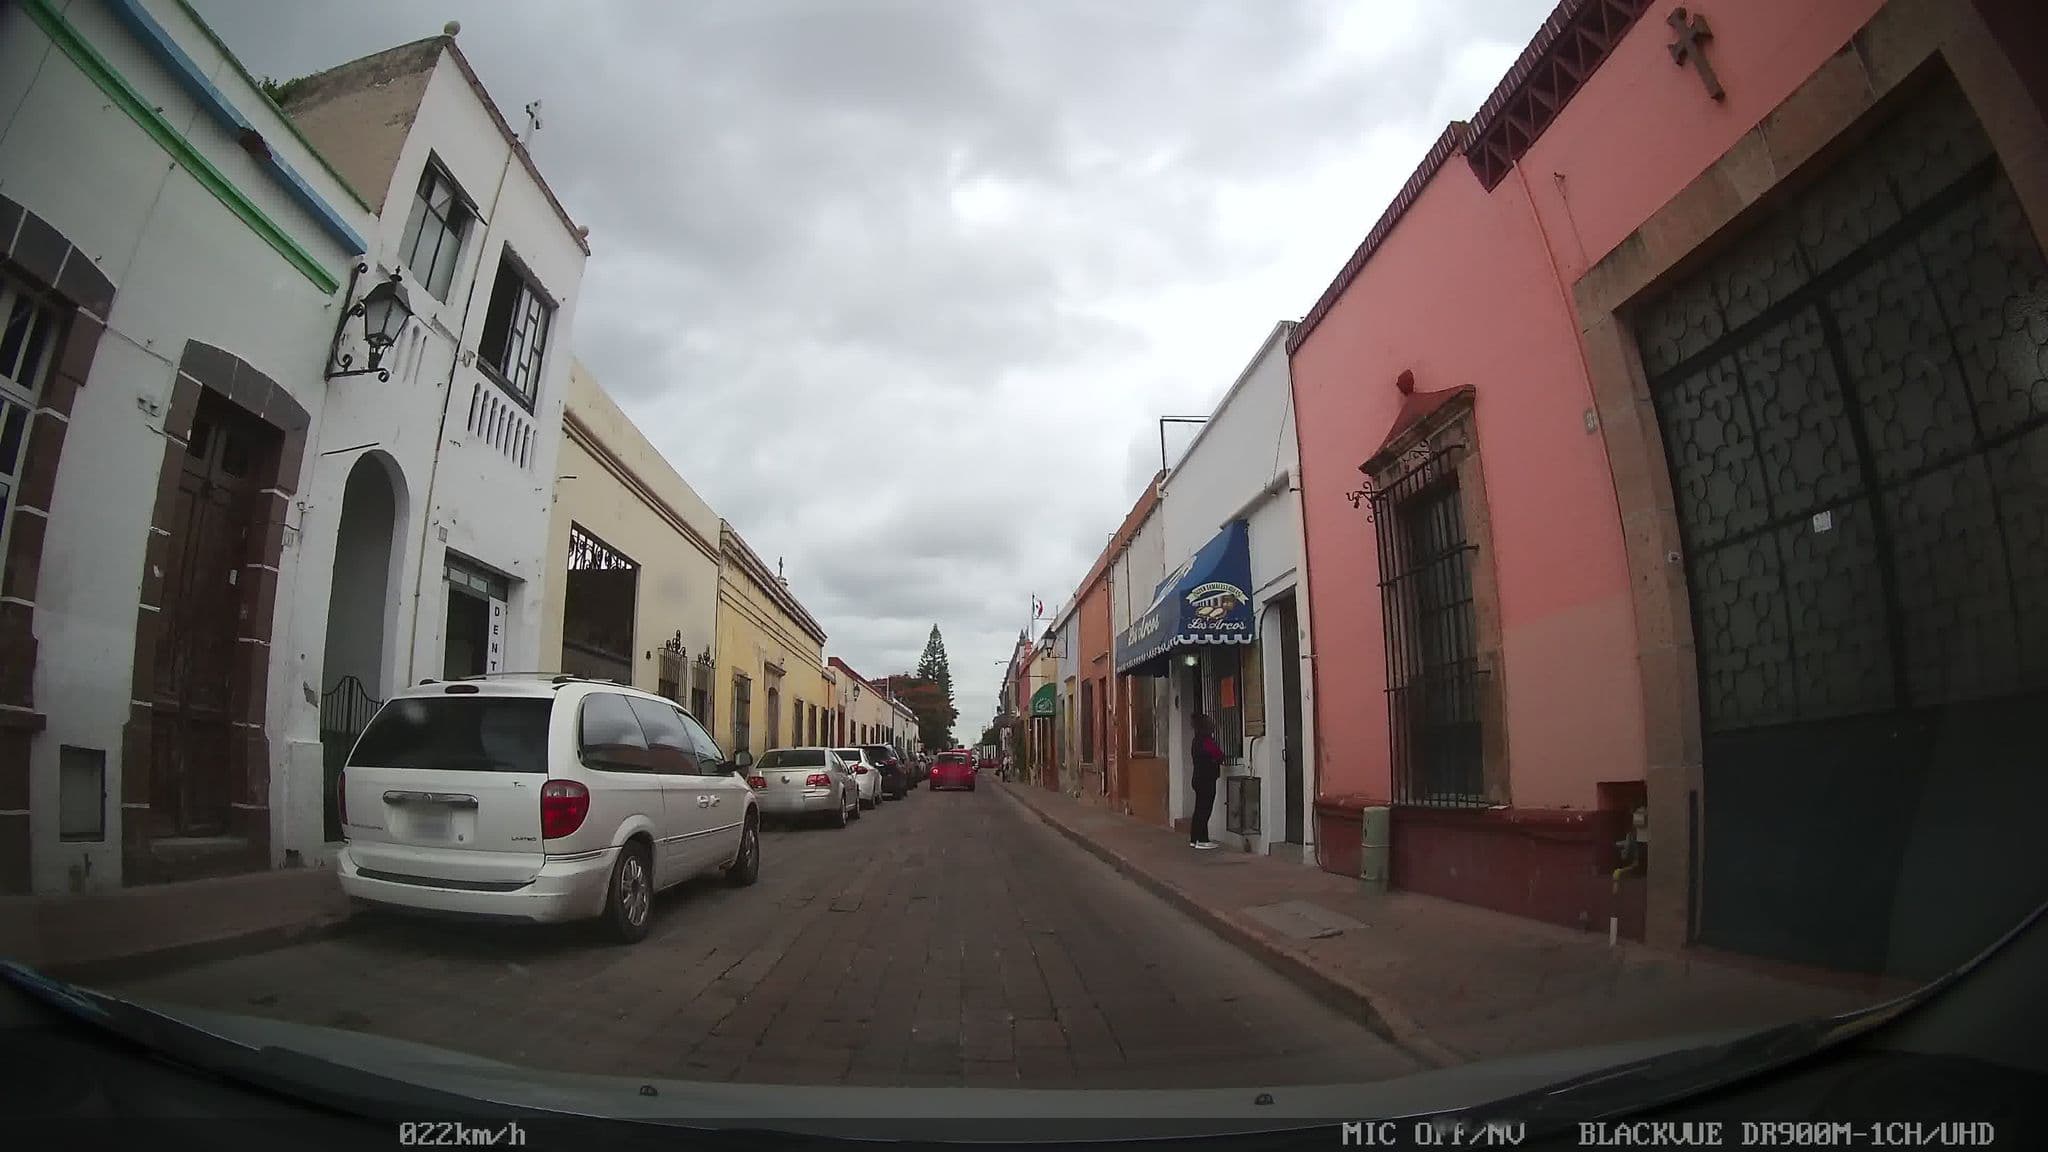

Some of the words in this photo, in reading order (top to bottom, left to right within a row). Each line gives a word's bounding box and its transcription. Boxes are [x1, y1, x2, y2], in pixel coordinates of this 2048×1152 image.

[491, 606, 500, 671] DENT
[1187, 617, 1207, 630] Los
[1208, 618, 1246, 630] Arcos
